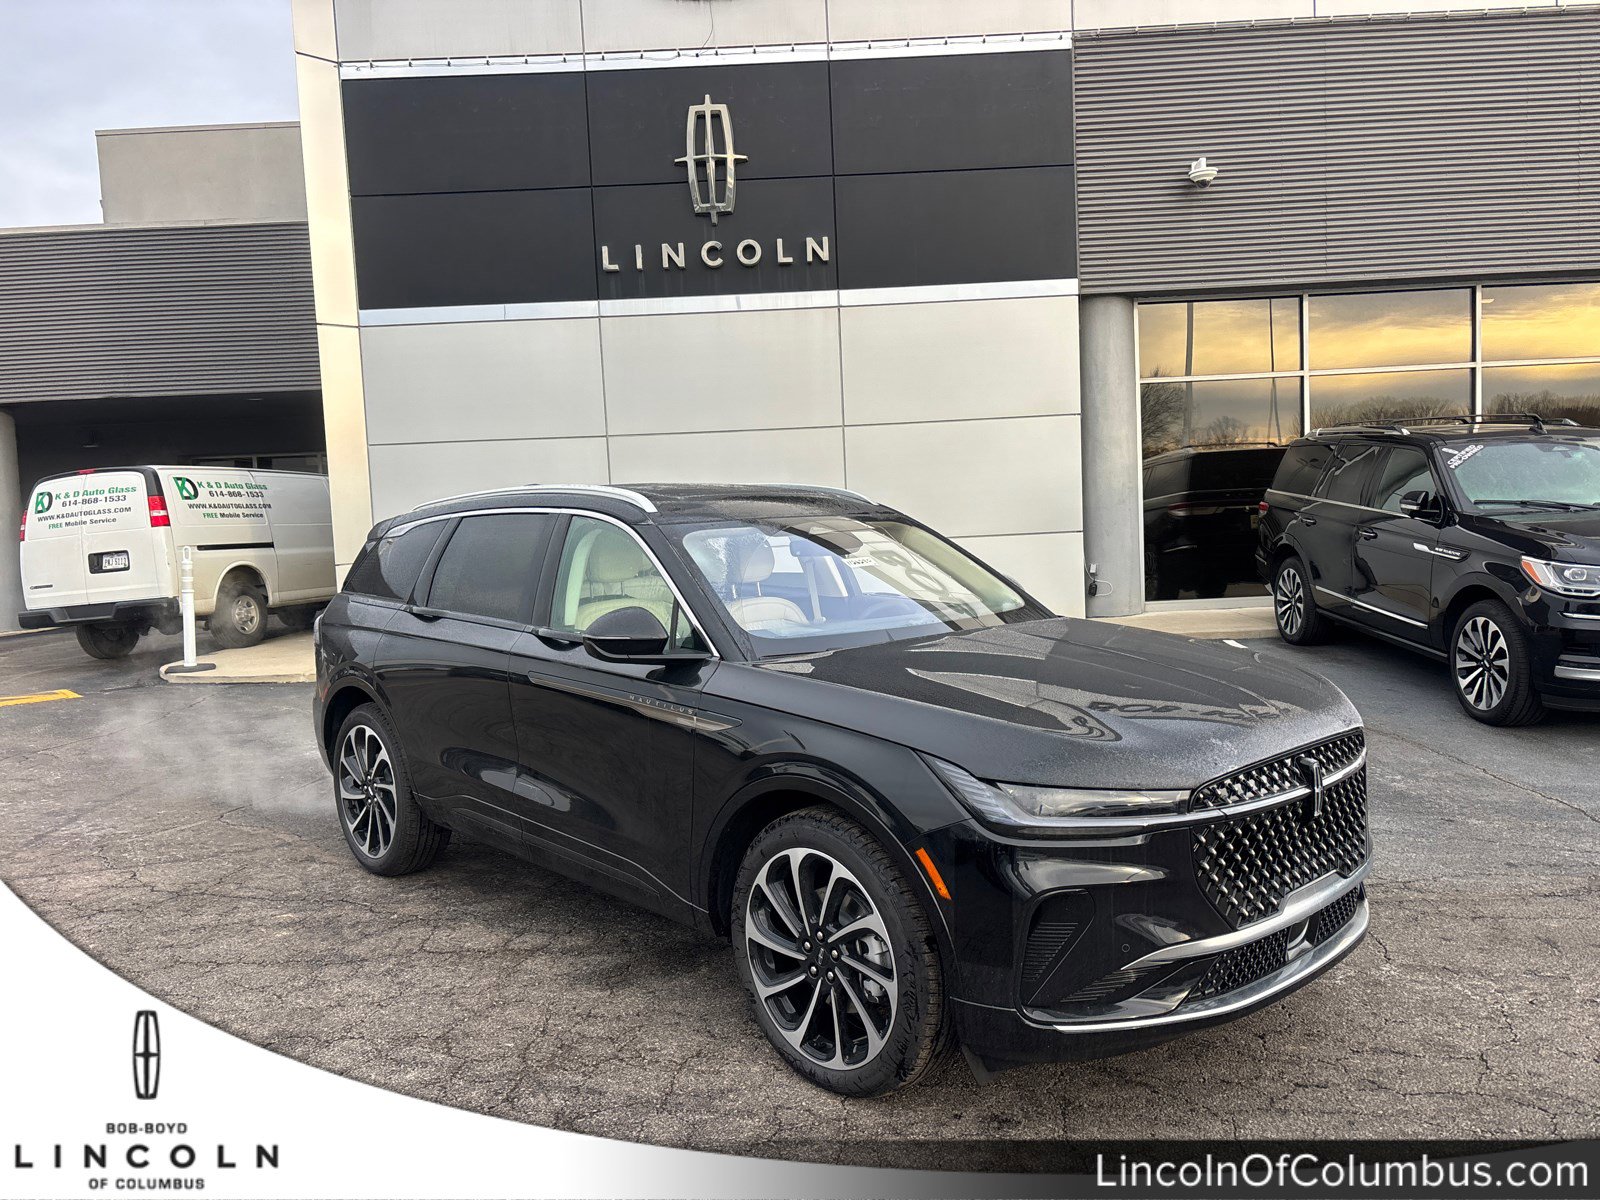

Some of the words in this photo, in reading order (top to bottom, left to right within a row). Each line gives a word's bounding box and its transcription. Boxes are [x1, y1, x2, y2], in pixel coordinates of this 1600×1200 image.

[602, 236, 830, 272] LINCOLN
[196, 481, 205, 489] K
[206, 481, 213, 489] &
[215, 481, 222, 489] D
[224, 481, 244, 490] Auto
[245, 482, 268, 490] Glass
[63, 491, 71, 499] &
[73, 490, 80, 498] D
[81, 488, 105, 497] Auto
[107, 486, 137, 494] Glass
[208, 490, 264, 498] 614-868-1533
[61, 494, 127, 508] 614-868-1533
[37, 507, 132, 522] WWW.K&DAUTOGLASS.COM
[48, 522, 63, 530] FREE
[64, 519, 88, 528] Mobile
[89, 517, 117, 525] Service
[629, 694, 694, 715] NAUTILUS
